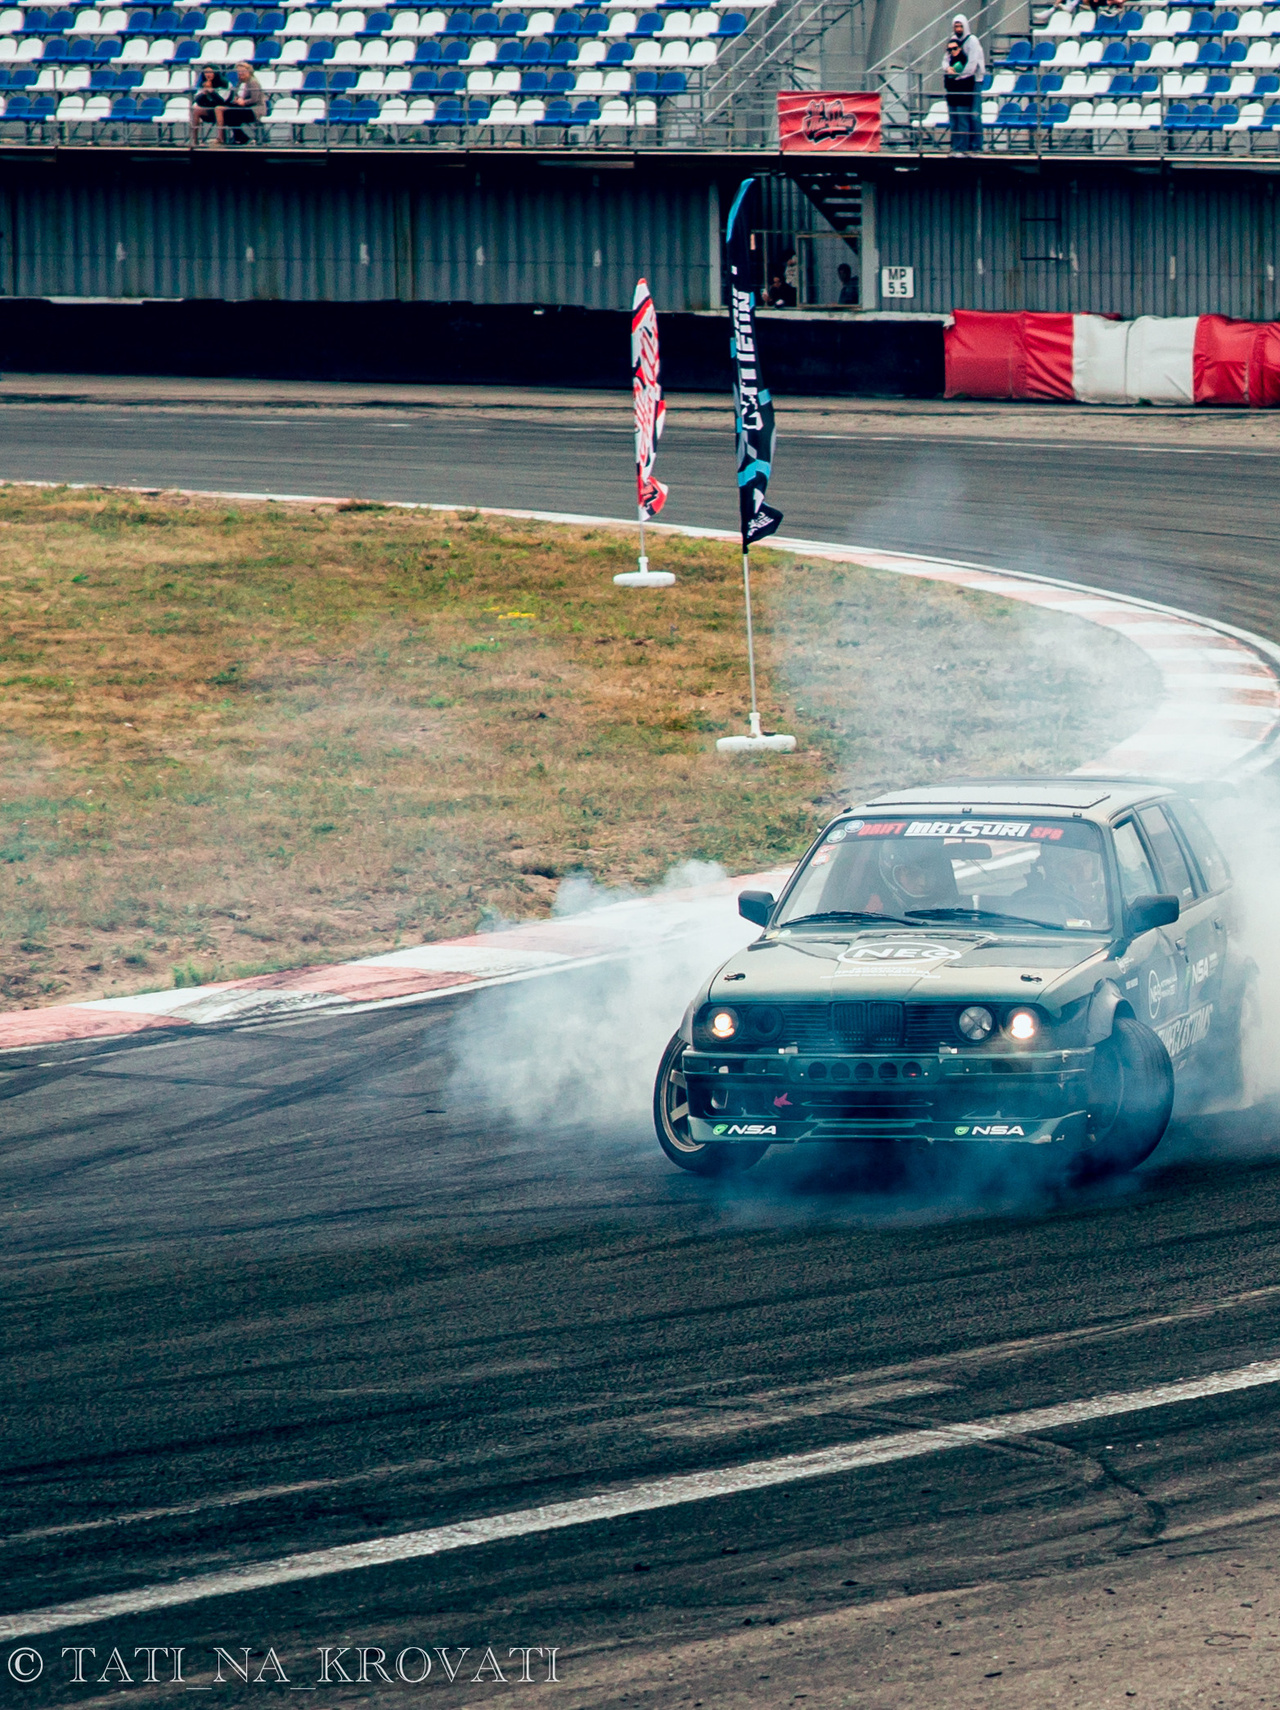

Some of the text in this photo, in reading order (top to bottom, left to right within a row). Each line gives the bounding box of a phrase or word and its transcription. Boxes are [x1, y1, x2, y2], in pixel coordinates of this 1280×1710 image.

[888, 268, 907, 280] MP
[888, 282, 907, 295] 5.5
[857, 822, 905, 836] DRIFT
[904, 821, 1032, 838] MATSURI
[852, 948, 961, 960] NEO
[1192, 957, 1210, 987] NSA
[727, 1124, 777, 1136] NSA
[972, 1125, 1024, 1136] NSA
